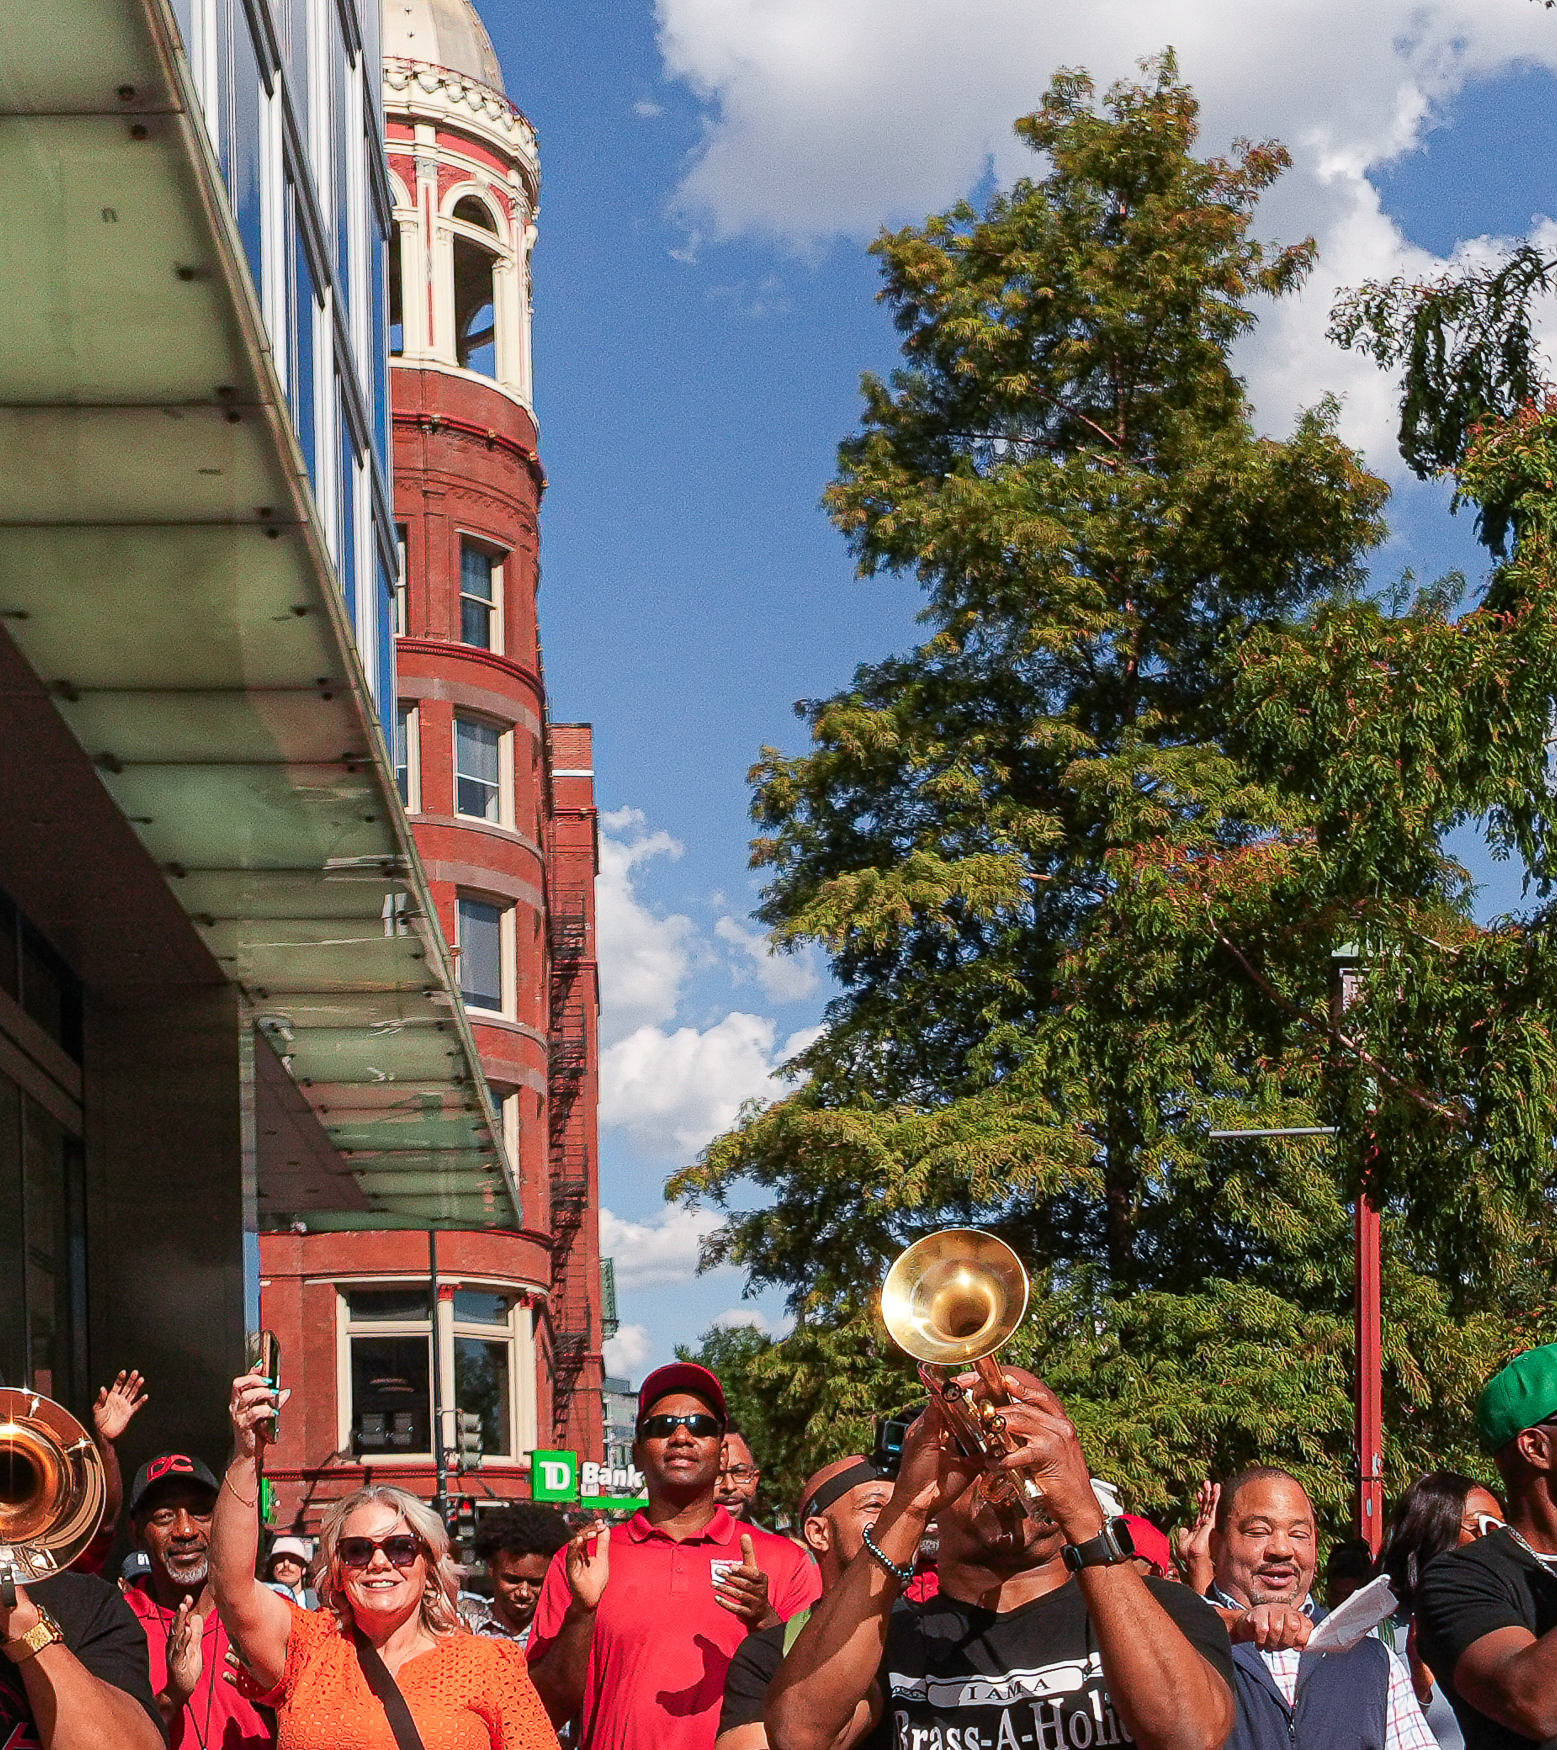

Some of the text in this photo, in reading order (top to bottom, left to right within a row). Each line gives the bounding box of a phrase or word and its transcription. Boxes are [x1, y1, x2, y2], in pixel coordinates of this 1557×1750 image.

[147, 1454, 194, 1482] DC
[539, 1461, 644, 1490] TD Bank
[968, 1678, 1051, 1700] I AM A
